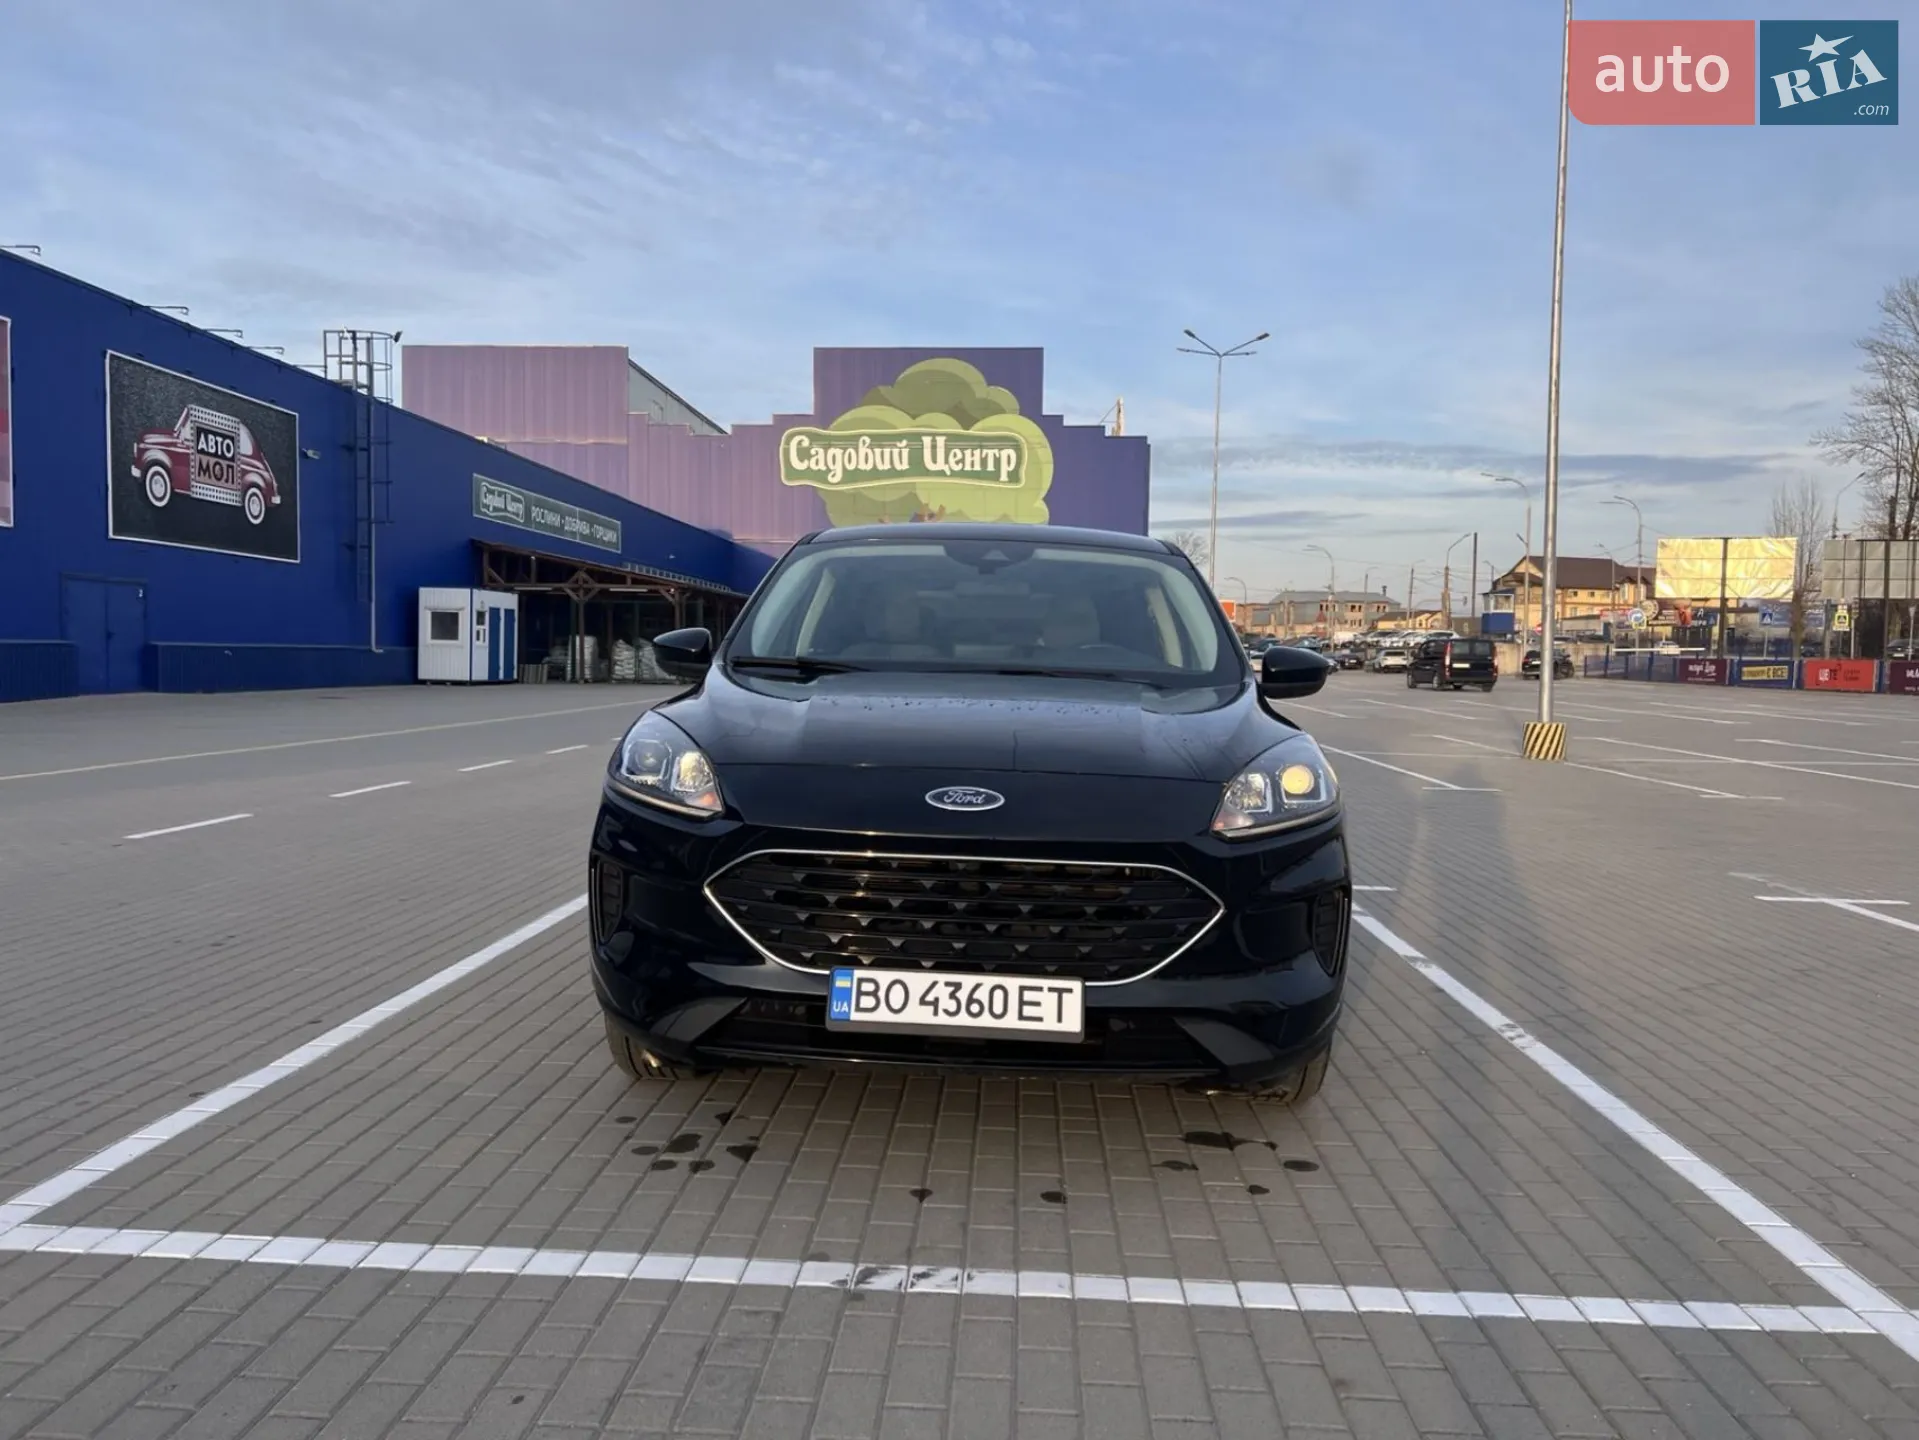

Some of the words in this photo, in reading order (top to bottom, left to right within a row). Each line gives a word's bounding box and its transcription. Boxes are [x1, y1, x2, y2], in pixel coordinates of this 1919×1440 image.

[197, 431, 234, 458] АВТО
[197, 457, 235, 485] МОЛ
[789, 434, 910, 483] Садовий
[921, 435, 1017, 482] Центр
[943, 789, 986, 804] Ford
[833, 1000, 849, 1013] UA
[854, 976, 910, 1015] BO
[918, 980, 1010, 1020] 4360
[1017, 985, 1074, 1024] ET
